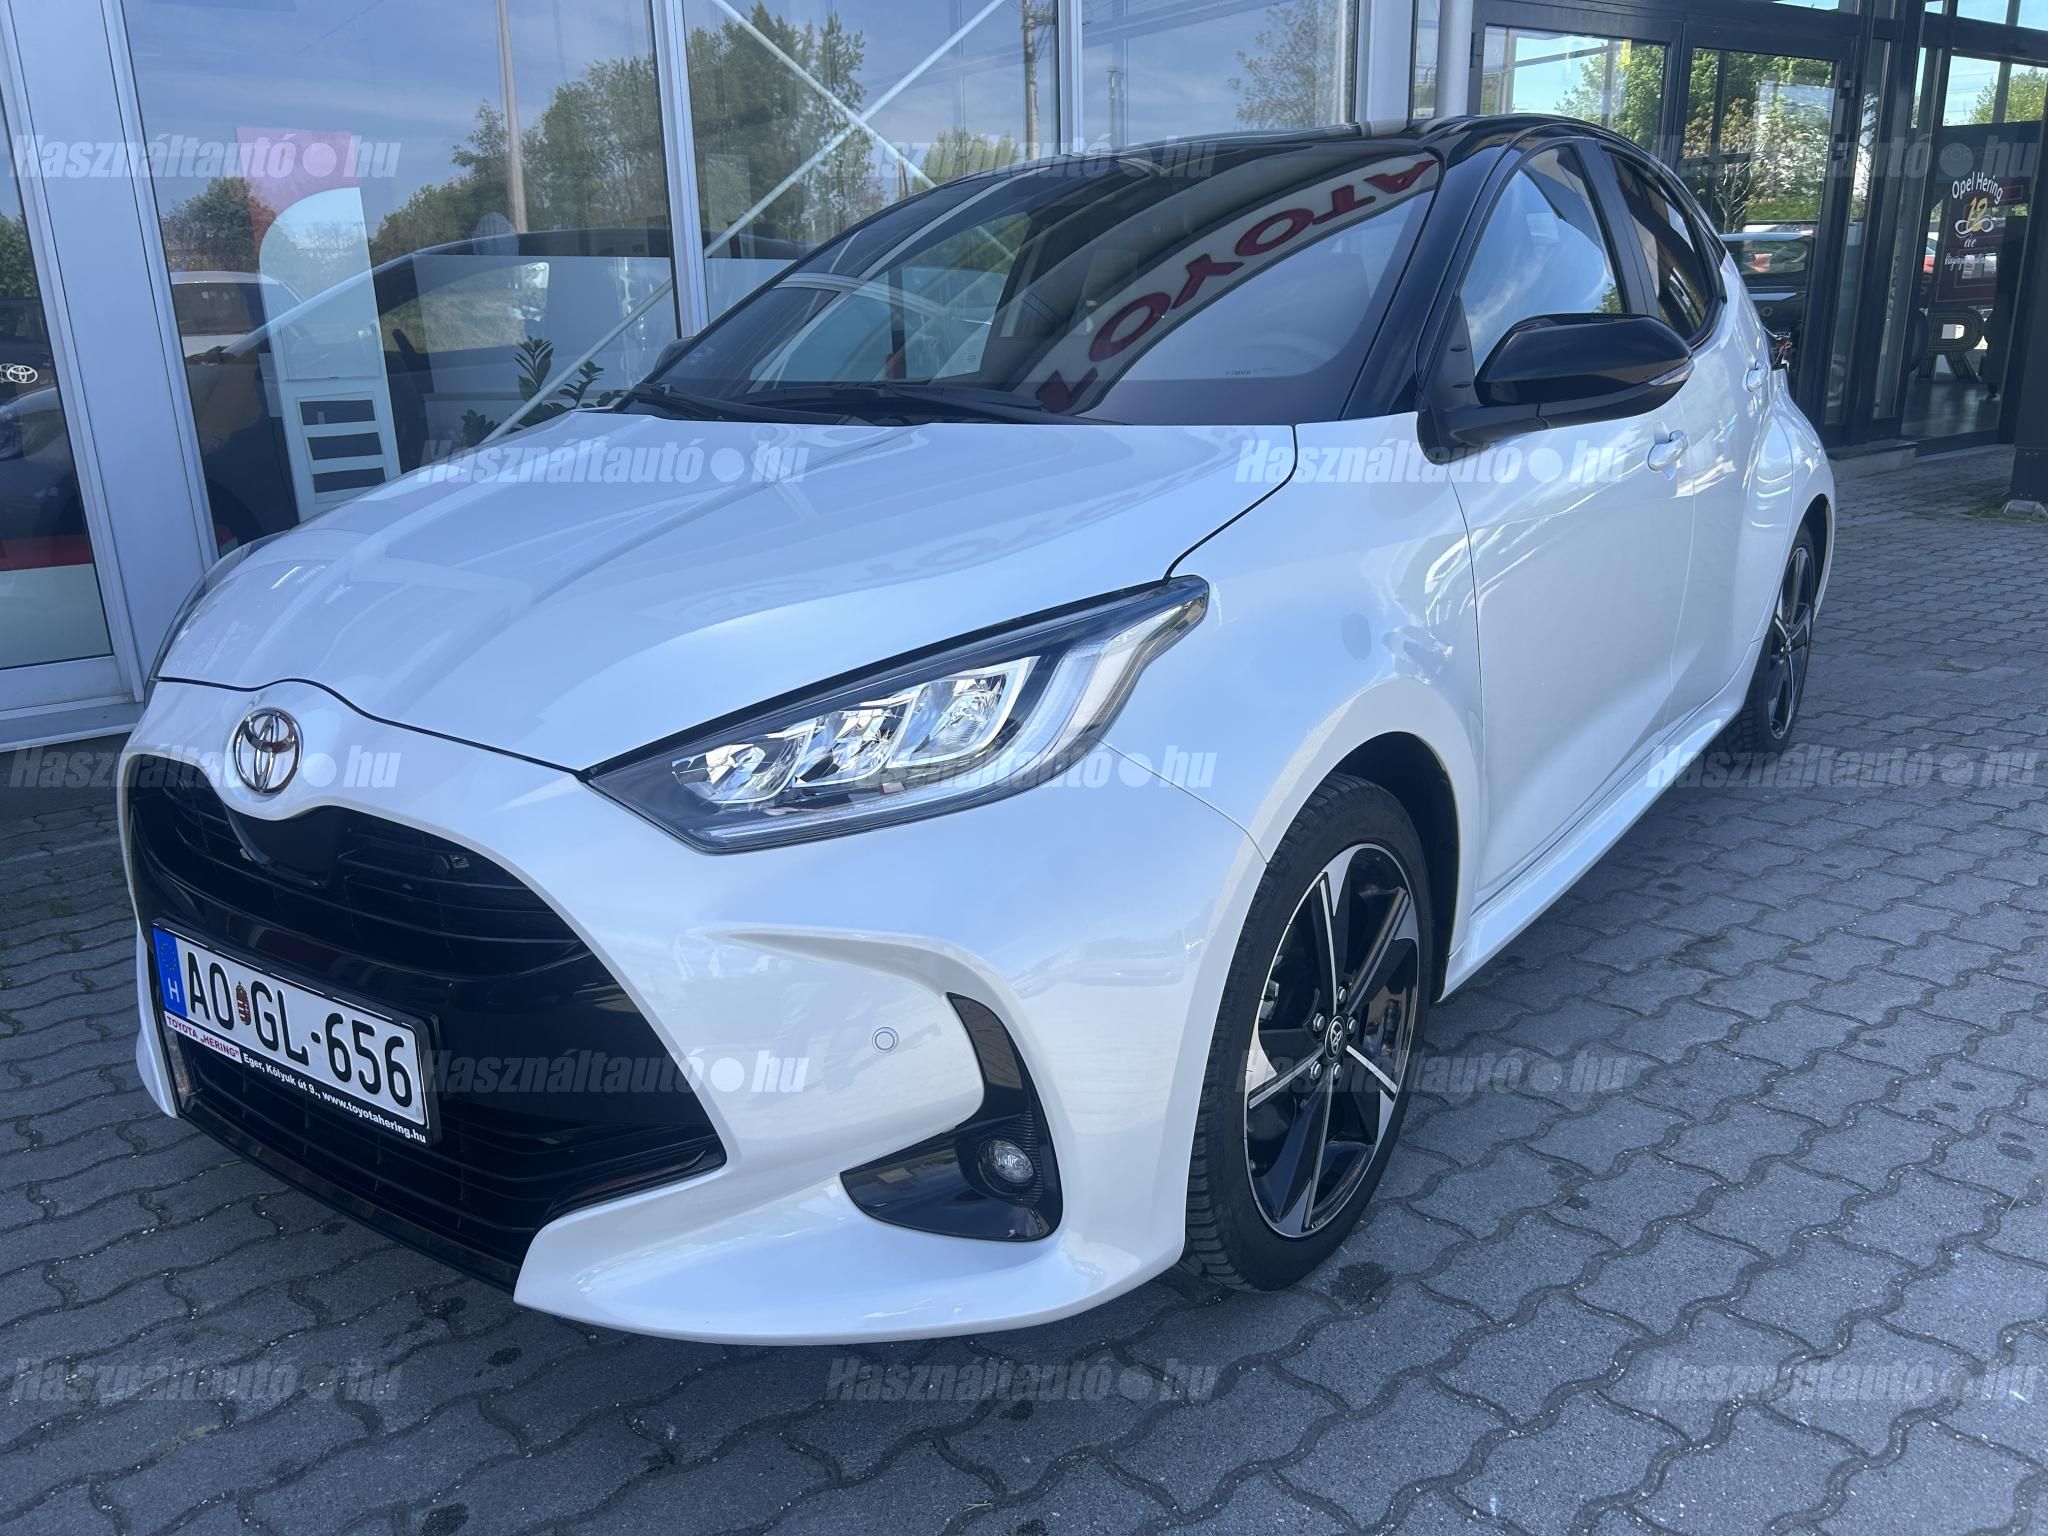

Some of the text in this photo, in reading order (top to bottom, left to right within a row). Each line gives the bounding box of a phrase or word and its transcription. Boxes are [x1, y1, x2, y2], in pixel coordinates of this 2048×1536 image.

[1951, 171, 2003, 205] Opel Hering
[167, 977, 180, 1003] H
[187, 951, 234, 1030] AO
[167, 1015, 198, 1038] TOYOTA
[243, 1053, 266, 1073] Eger,
[298, 1078, 308, 1091] út
[321, 1091, 427, 1144] www.toyotahering.hu
